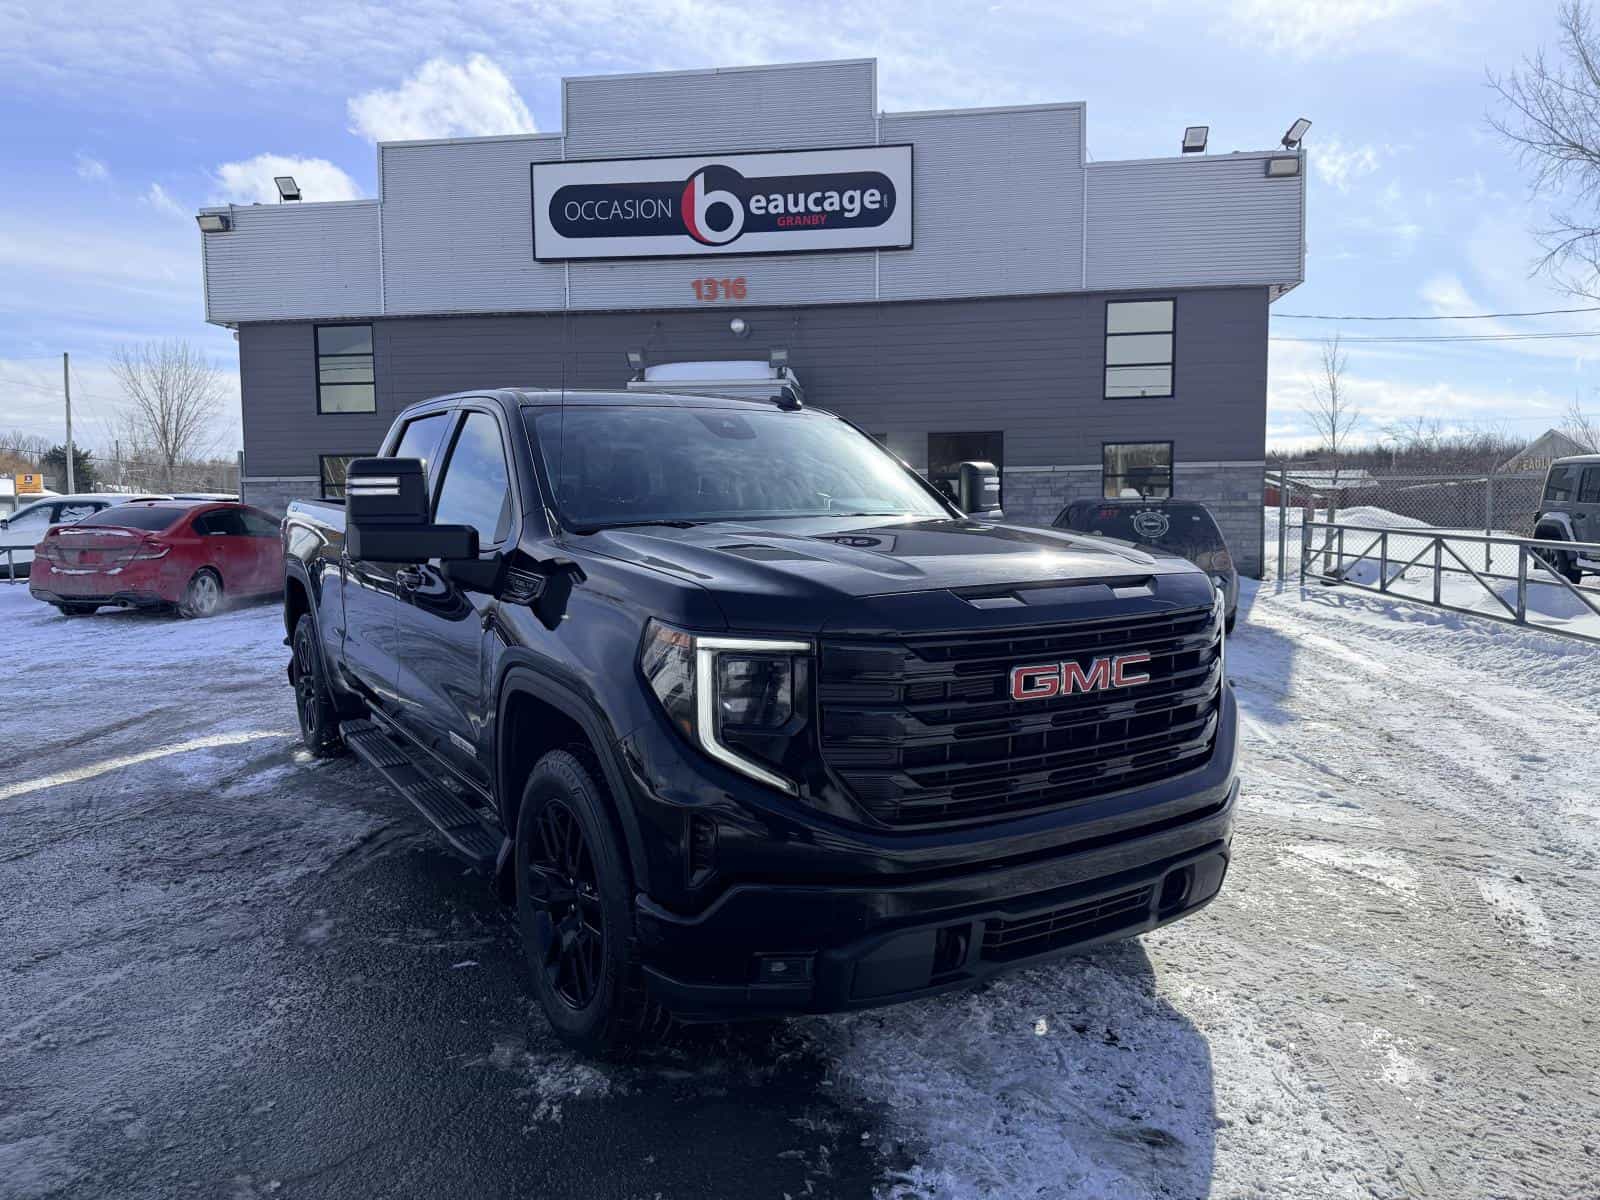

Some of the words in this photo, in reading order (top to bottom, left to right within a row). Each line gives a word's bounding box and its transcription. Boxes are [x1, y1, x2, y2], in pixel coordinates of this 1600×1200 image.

[564, 199, 672, 221] OCCASION
[777, 215, 827, 226] GRANBY
[691, 278, 747, 301] 1316
[1010, 652, 1151, 700] GMC
